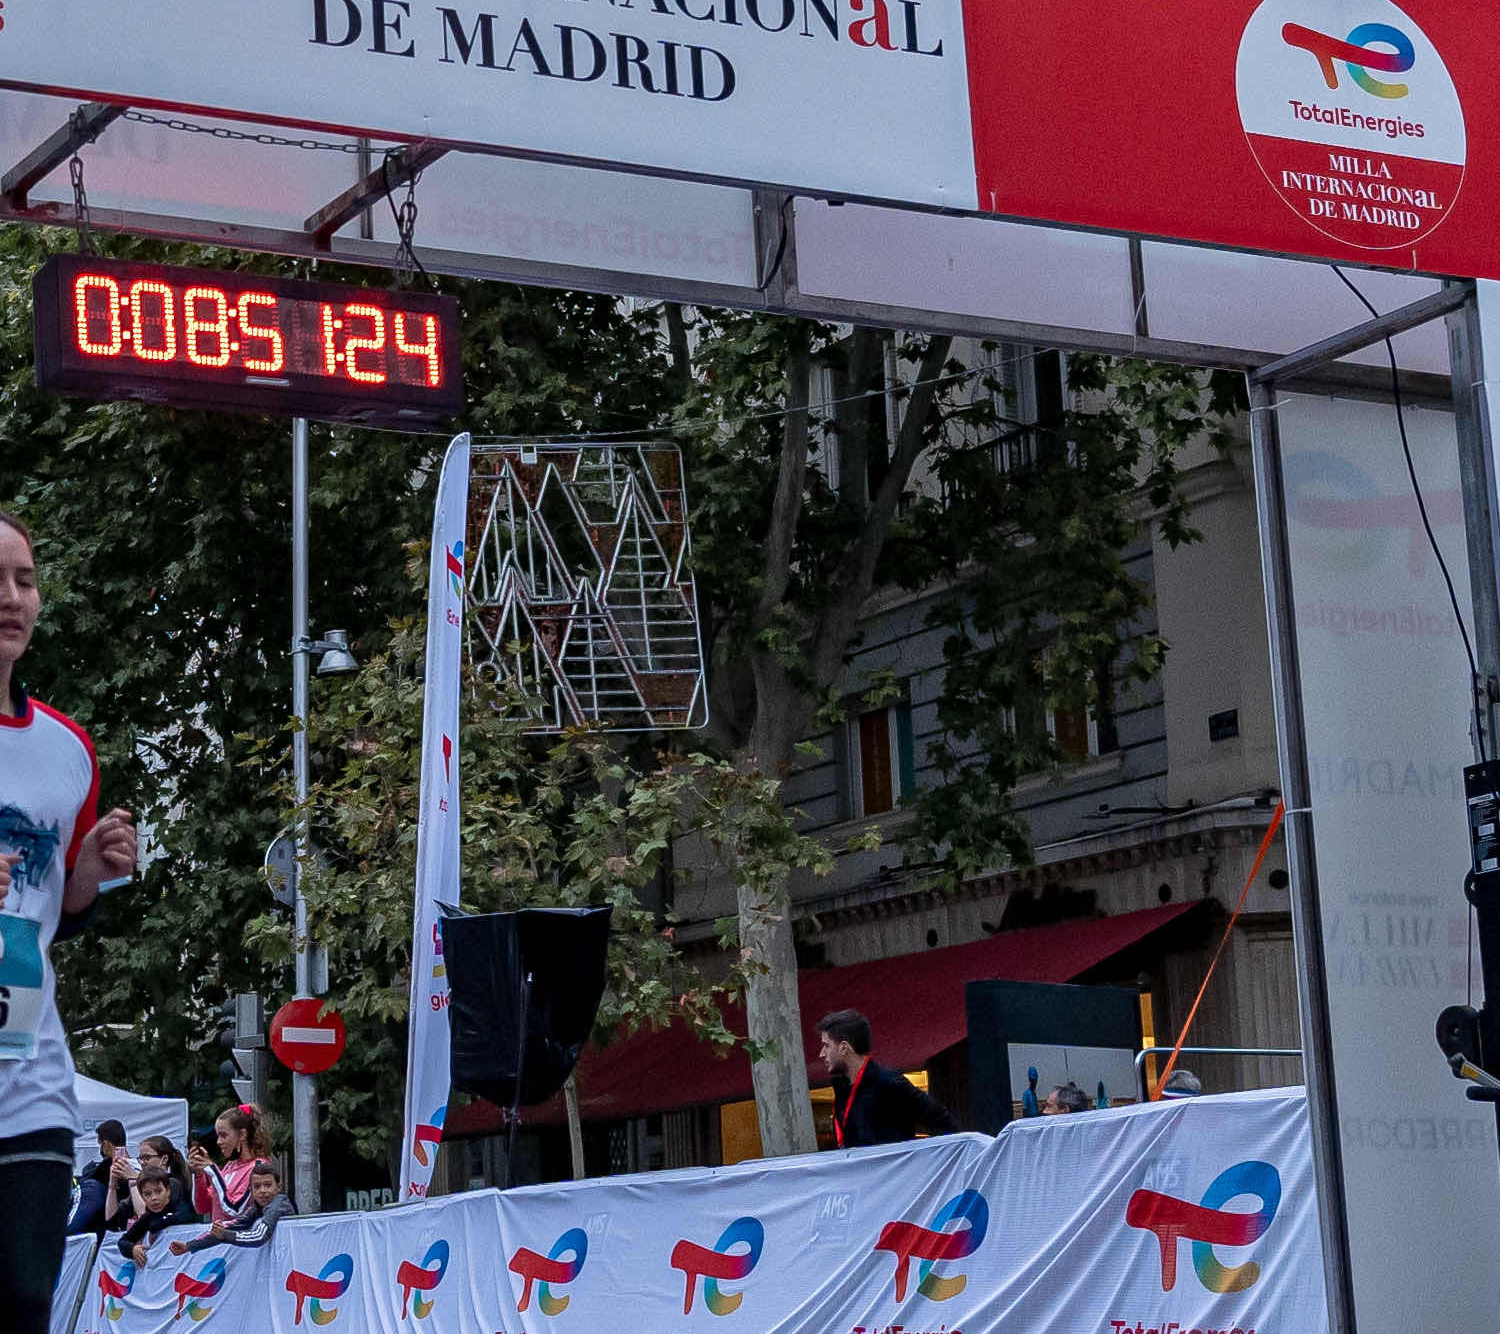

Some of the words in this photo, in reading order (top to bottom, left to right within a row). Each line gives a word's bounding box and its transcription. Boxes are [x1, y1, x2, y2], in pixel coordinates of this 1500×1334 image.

[437, 6, 736, 103] MADRID
[1288, 100, 1424, 138] TotalEnergies
[1328, 154, 1393, 180] MILLA
[1309, 197, 1338, 218] DE
[1342, 202, 1420, 230] MADRID
